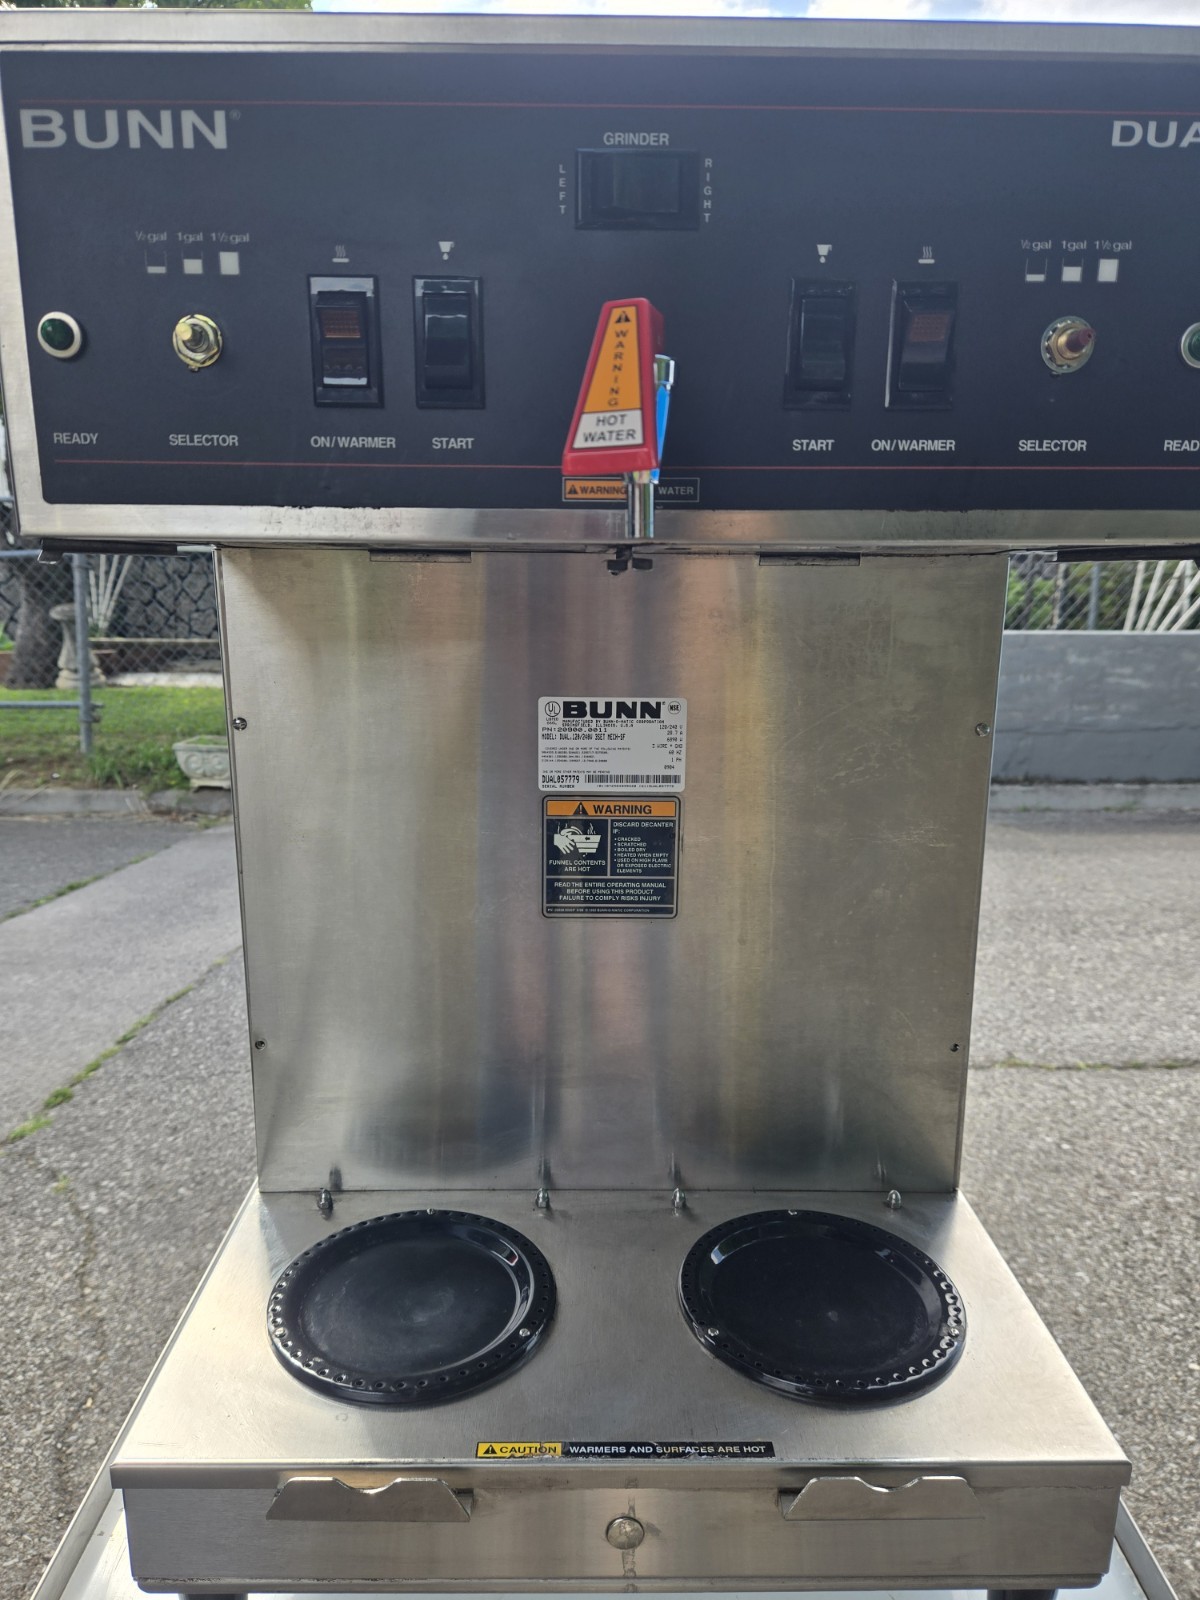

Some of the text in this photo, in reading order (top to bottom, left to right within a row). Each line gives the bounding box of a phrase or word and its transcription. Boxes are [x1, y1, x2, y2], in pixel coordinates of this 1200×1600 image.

[603, 132, 670, 146] GRINDER
[558, 163, 567, 215] LEFT
[704, 157, 713, 224] RIGHT
[607, 329, 629, 406] WARNING
[595, 413, 628, 427] HOT
[53, 432, 98, 445] READY
[168, 434, 239, 448] SELECTOR
[583, 429, 637, 443] WATER
[310, 436, 396, 450] ON/WARMER
[432, 437, 475, 450] START
[792, 439, 834, 452] START
[871, 439, 956, 452] ON/WARMER
[1018, 439, 1087, 452] SELECTOR
[580, 485, 695, 496] WARNING WATER
[542, 775, 580, 784] DUAL057779
[593, 804, 652, 814] WARNING
[500, 1445, 766, 1454] CAUTION WARMERS AND SURFACES ARE HOT
